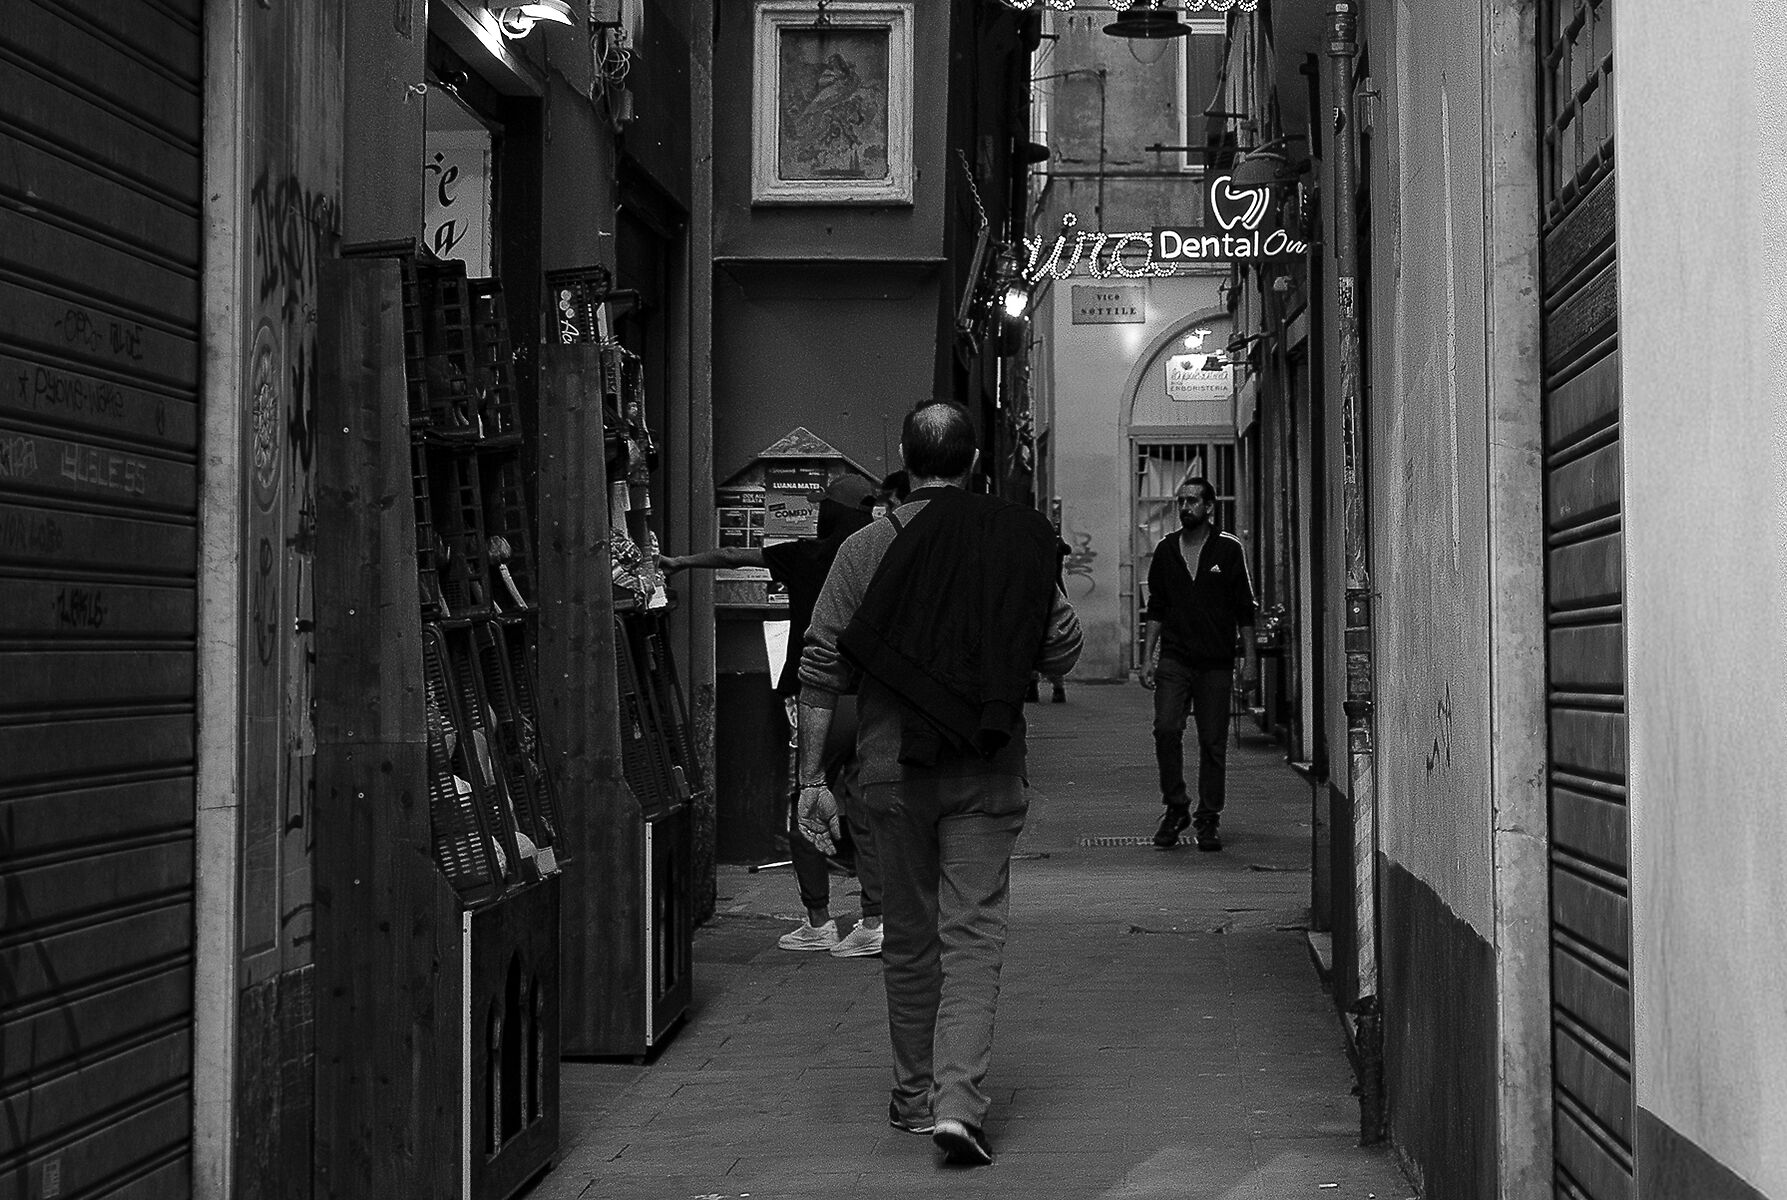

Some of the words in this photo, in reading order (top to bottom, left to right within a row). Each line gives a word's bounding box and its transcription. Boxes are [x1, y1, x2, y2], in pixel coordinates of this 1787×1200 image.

[1159, 230, 1259, 259] Dental
[1096, 293, 1120, 301] VICO
[1080, 307, 1137, 316] SOTTILE
[774, 507, 813, 518] COMEDY
